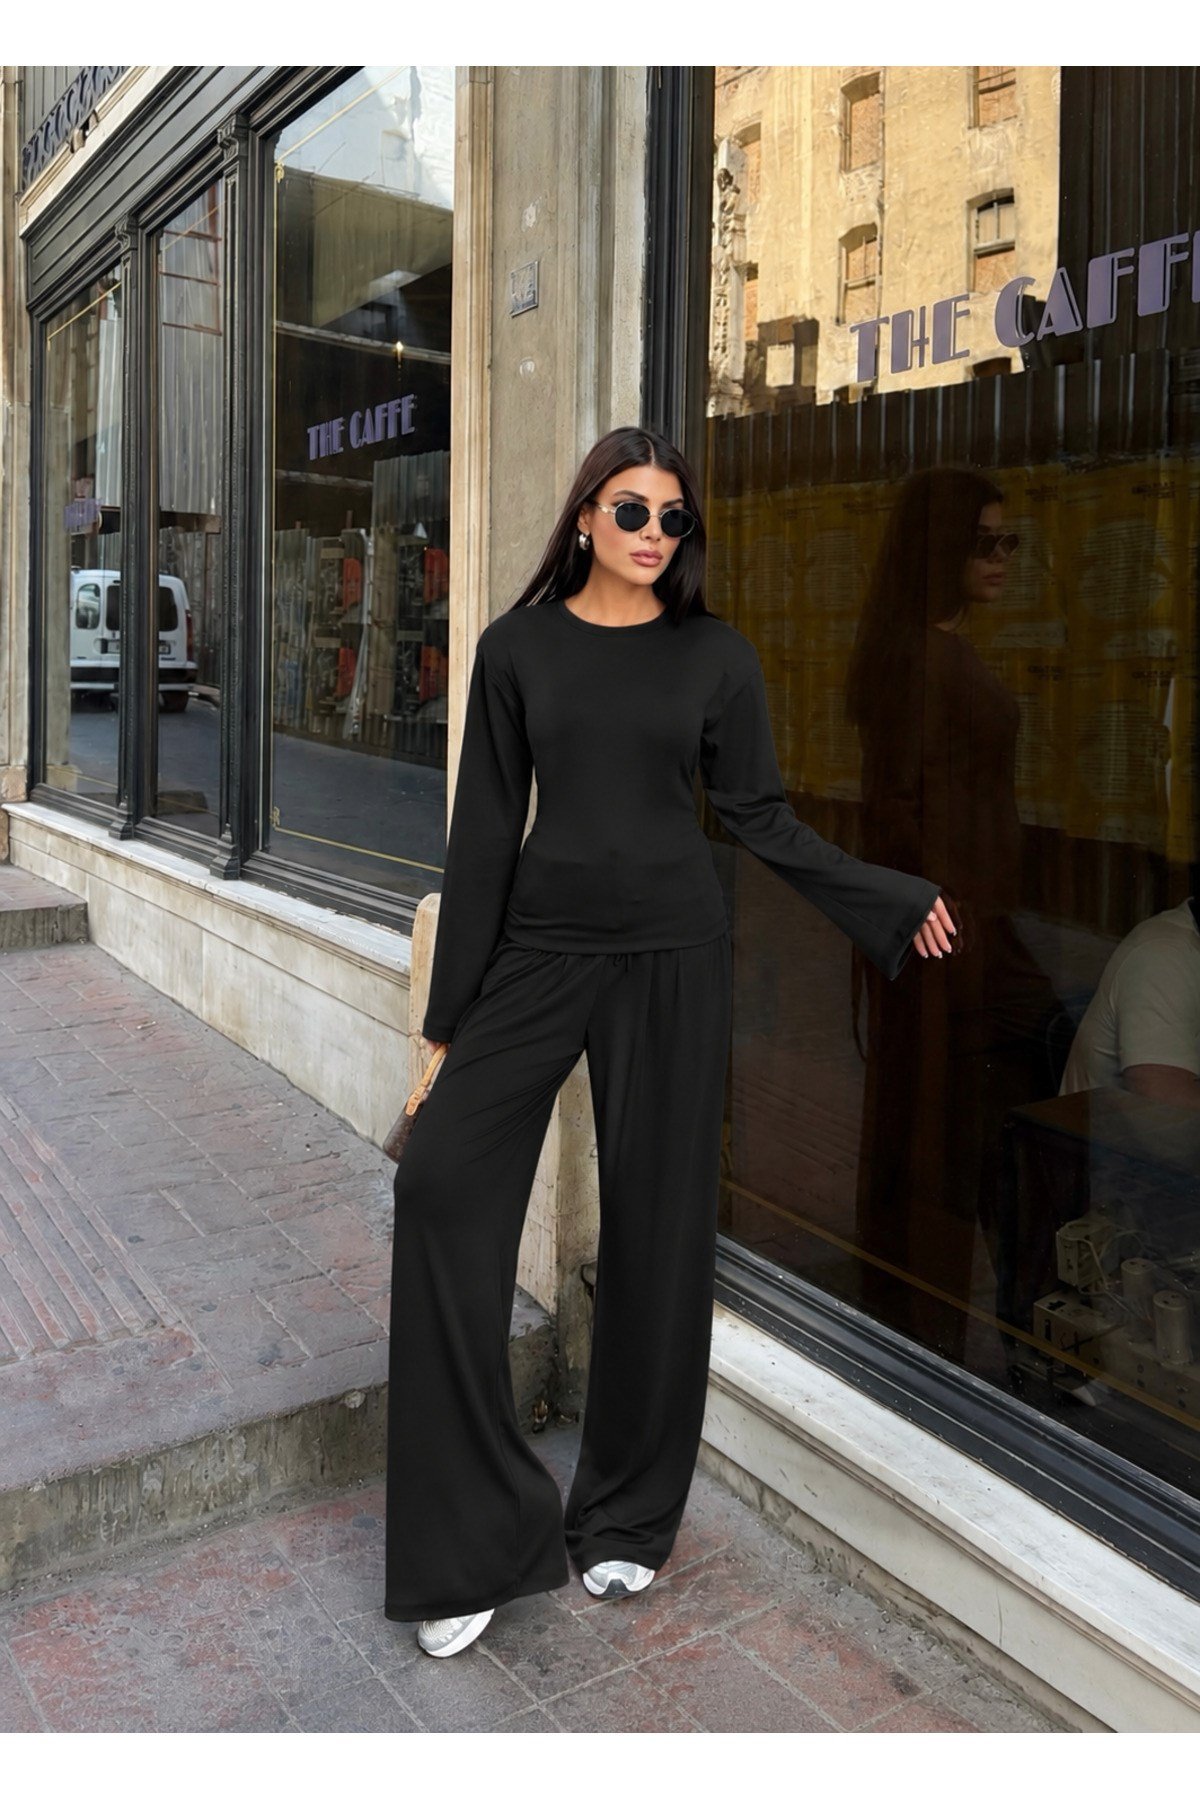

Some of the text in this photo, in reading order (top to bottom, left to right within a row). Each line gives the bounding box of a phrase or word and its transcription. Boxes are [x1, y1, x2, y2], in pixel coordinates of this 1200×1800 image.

[850, 229, 1200, 382] THE CAFF
[307, 393, 417, 460] THE CAFFE
